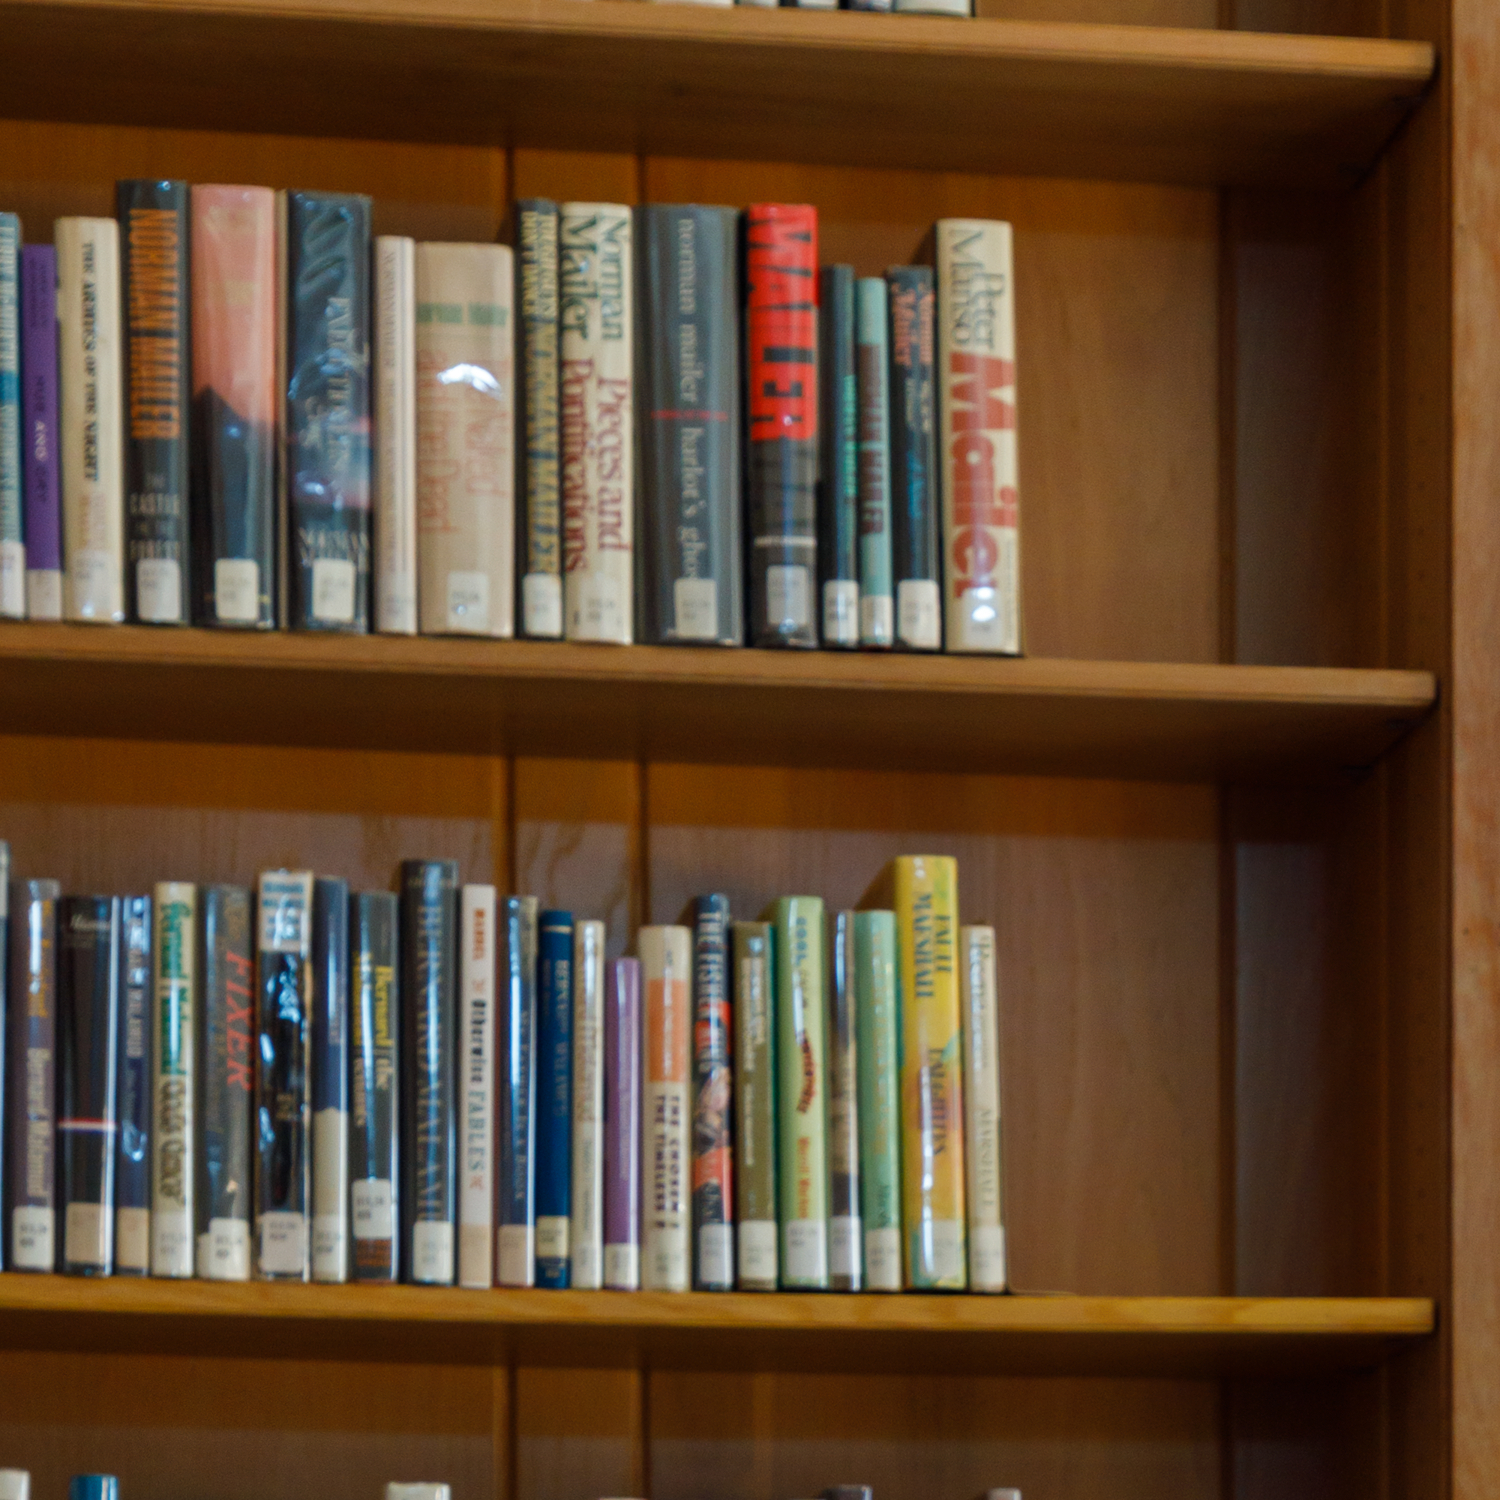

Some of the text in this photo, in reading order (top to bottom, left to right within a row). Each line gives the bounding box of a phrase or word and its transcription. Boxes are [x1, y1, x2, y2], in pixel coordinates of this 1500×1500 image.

[129, 209, 180, 440] NORMAN MAILER
[561, 214, 598, 338] Mailer
[600, 216, 630, 340] Norman
[678, 219, 697, 314] norman
[748, 204, 816, 441] MAILER
[679, 324, 701, 403] mailer
[561, 358, 593, 572] Pontifications
[597, 376, 631, 551] Pieces and
[950, 352, 1018, 599] Mailer
[697, 952, 721, 1017] FISHER
[698, 912, 722, 944] THE
[912, 892, 934, 1000] MARSHALL
[226, 950, 256, 1090] FIXER
[415, 1081, 444, 1222] MALAMU
[467, 1091, 487, 1172] FABLES
